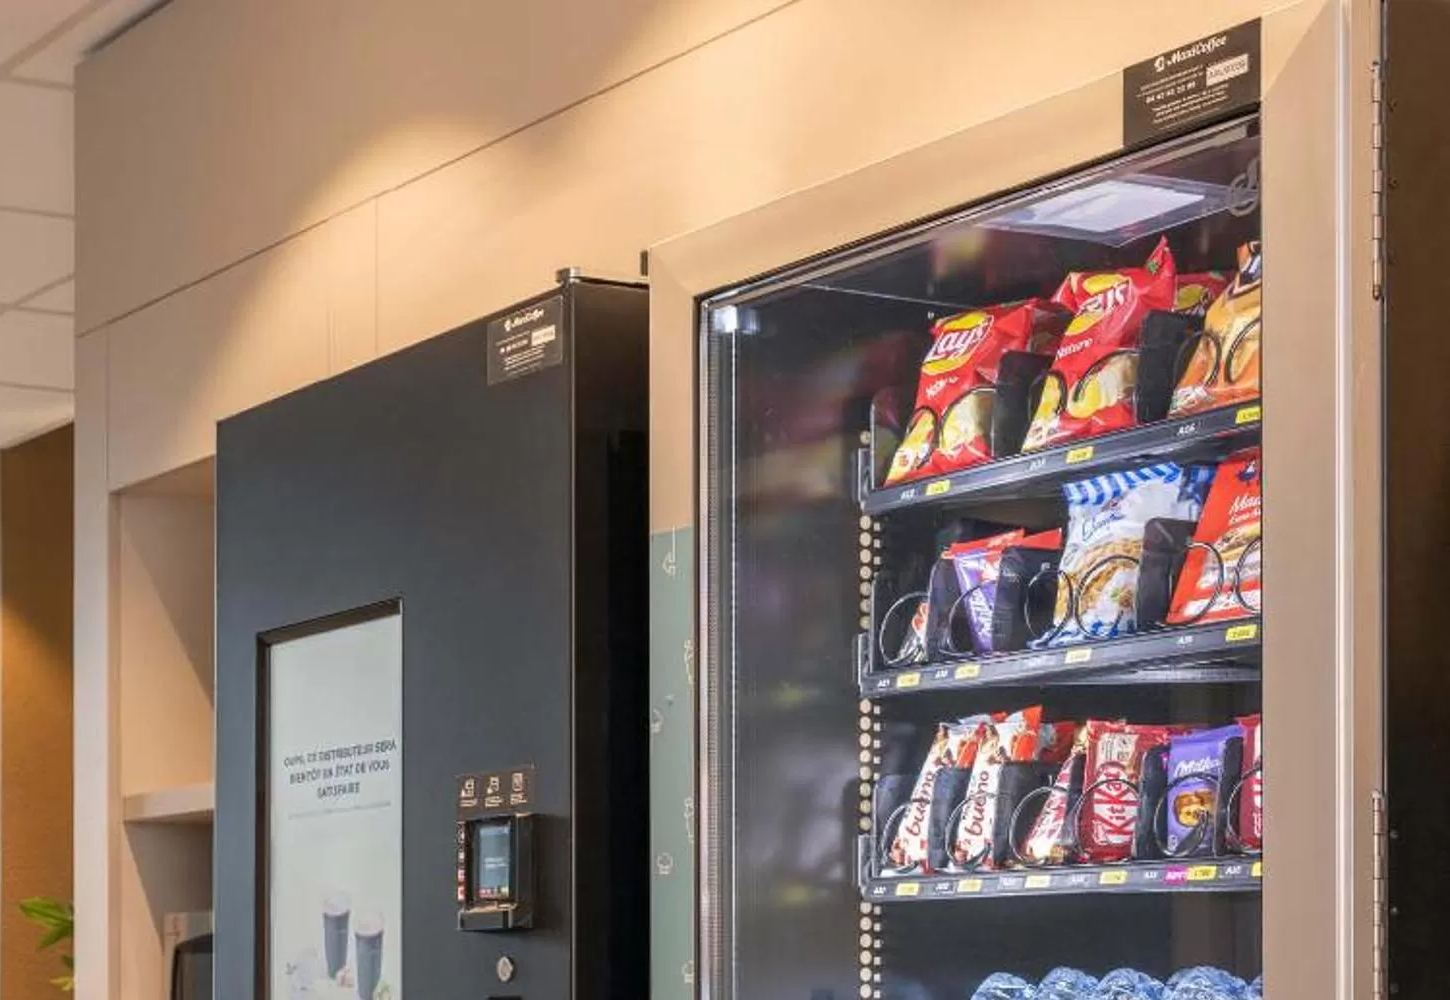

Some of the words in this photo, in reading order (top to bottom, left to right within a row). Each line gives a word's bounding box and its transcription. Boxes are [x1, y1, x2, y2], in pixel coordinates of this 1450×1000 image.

[923, 322, 988, 362] Lay's
[375, 738, 397, 753] SERA
[368, 759, 391, 773] VOUS
